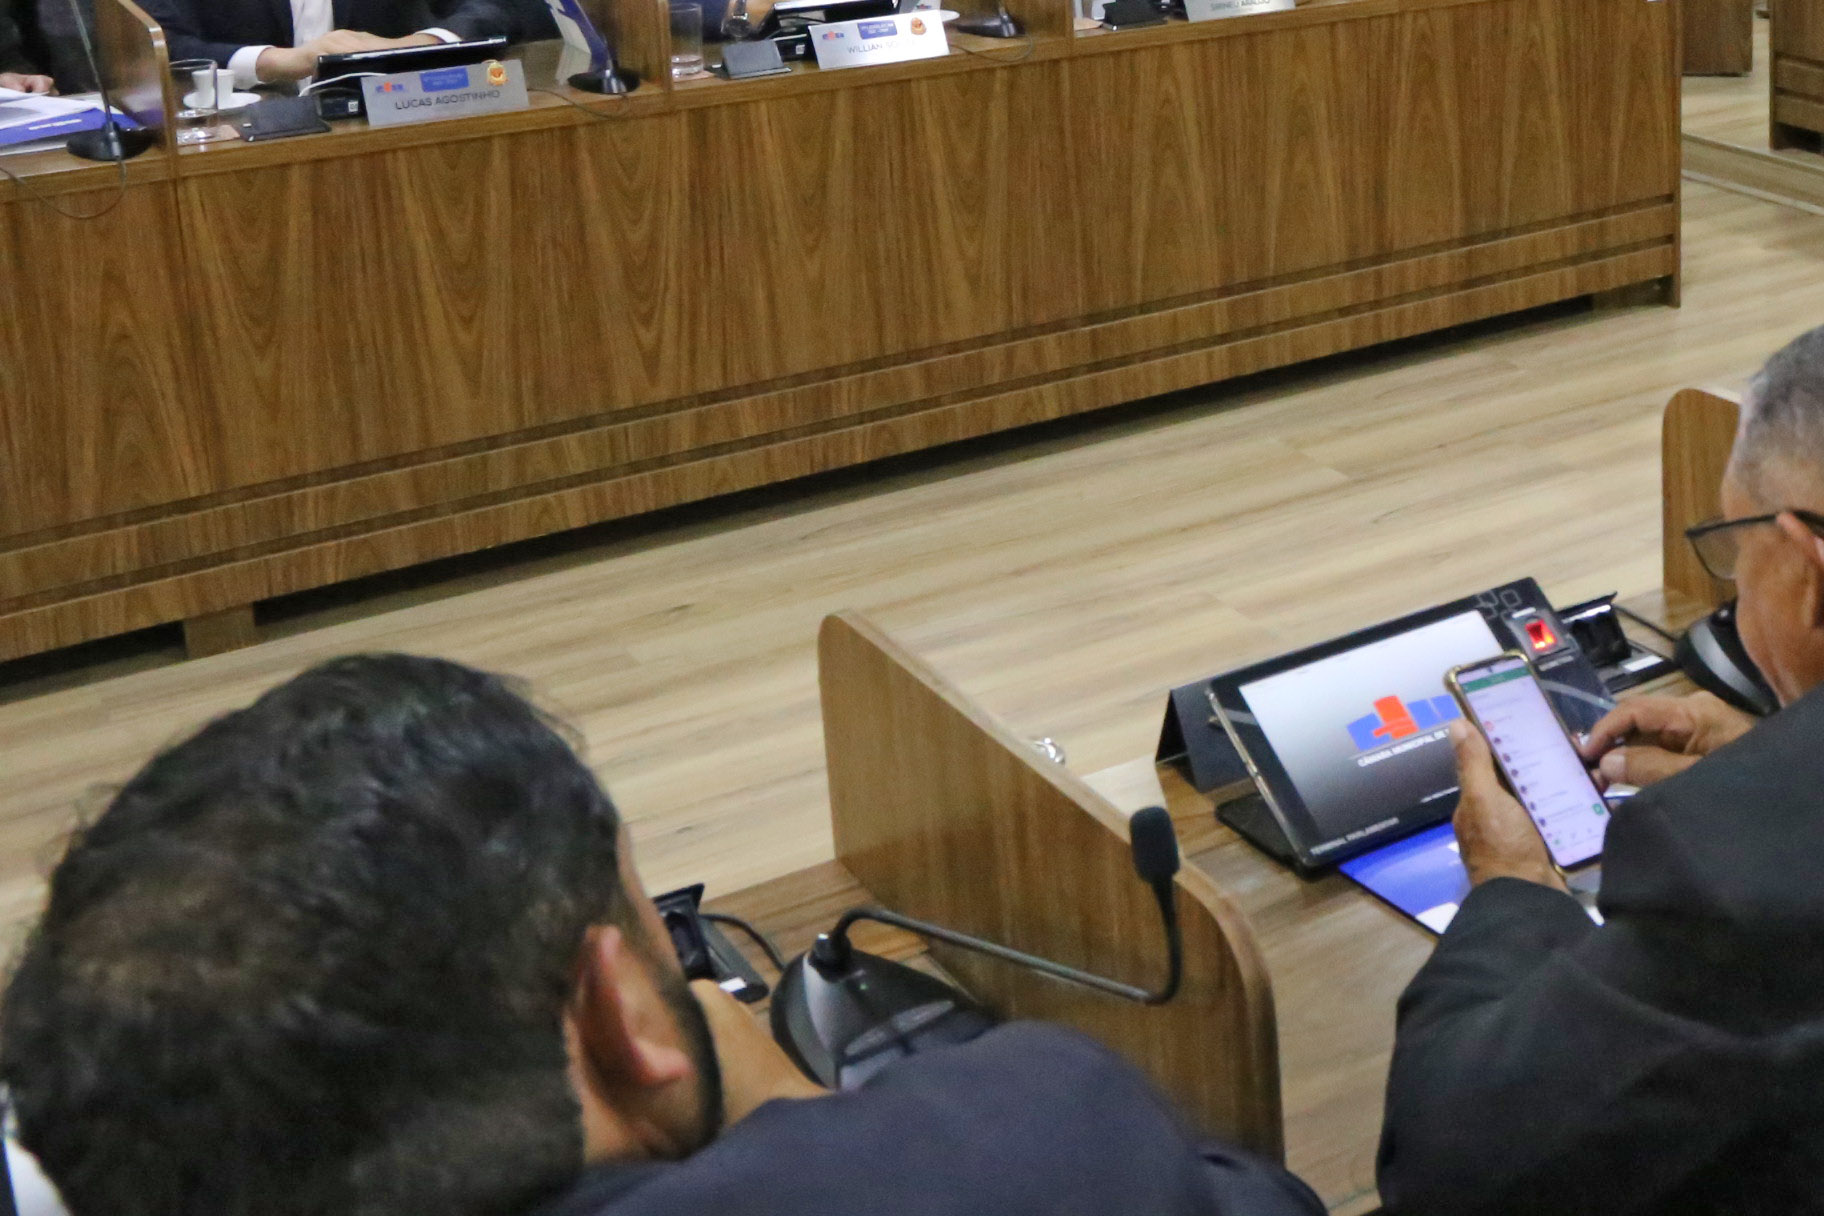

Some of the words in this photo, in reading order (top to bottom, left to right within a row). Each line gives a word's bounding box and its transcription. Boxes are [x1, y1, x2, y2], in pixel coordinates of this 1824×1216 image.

[846, 42, 883, 54] WILLIAN
[395, 99, 432, 110] LUCAS
[435, 90, 500, 105] AGOSTINHO
